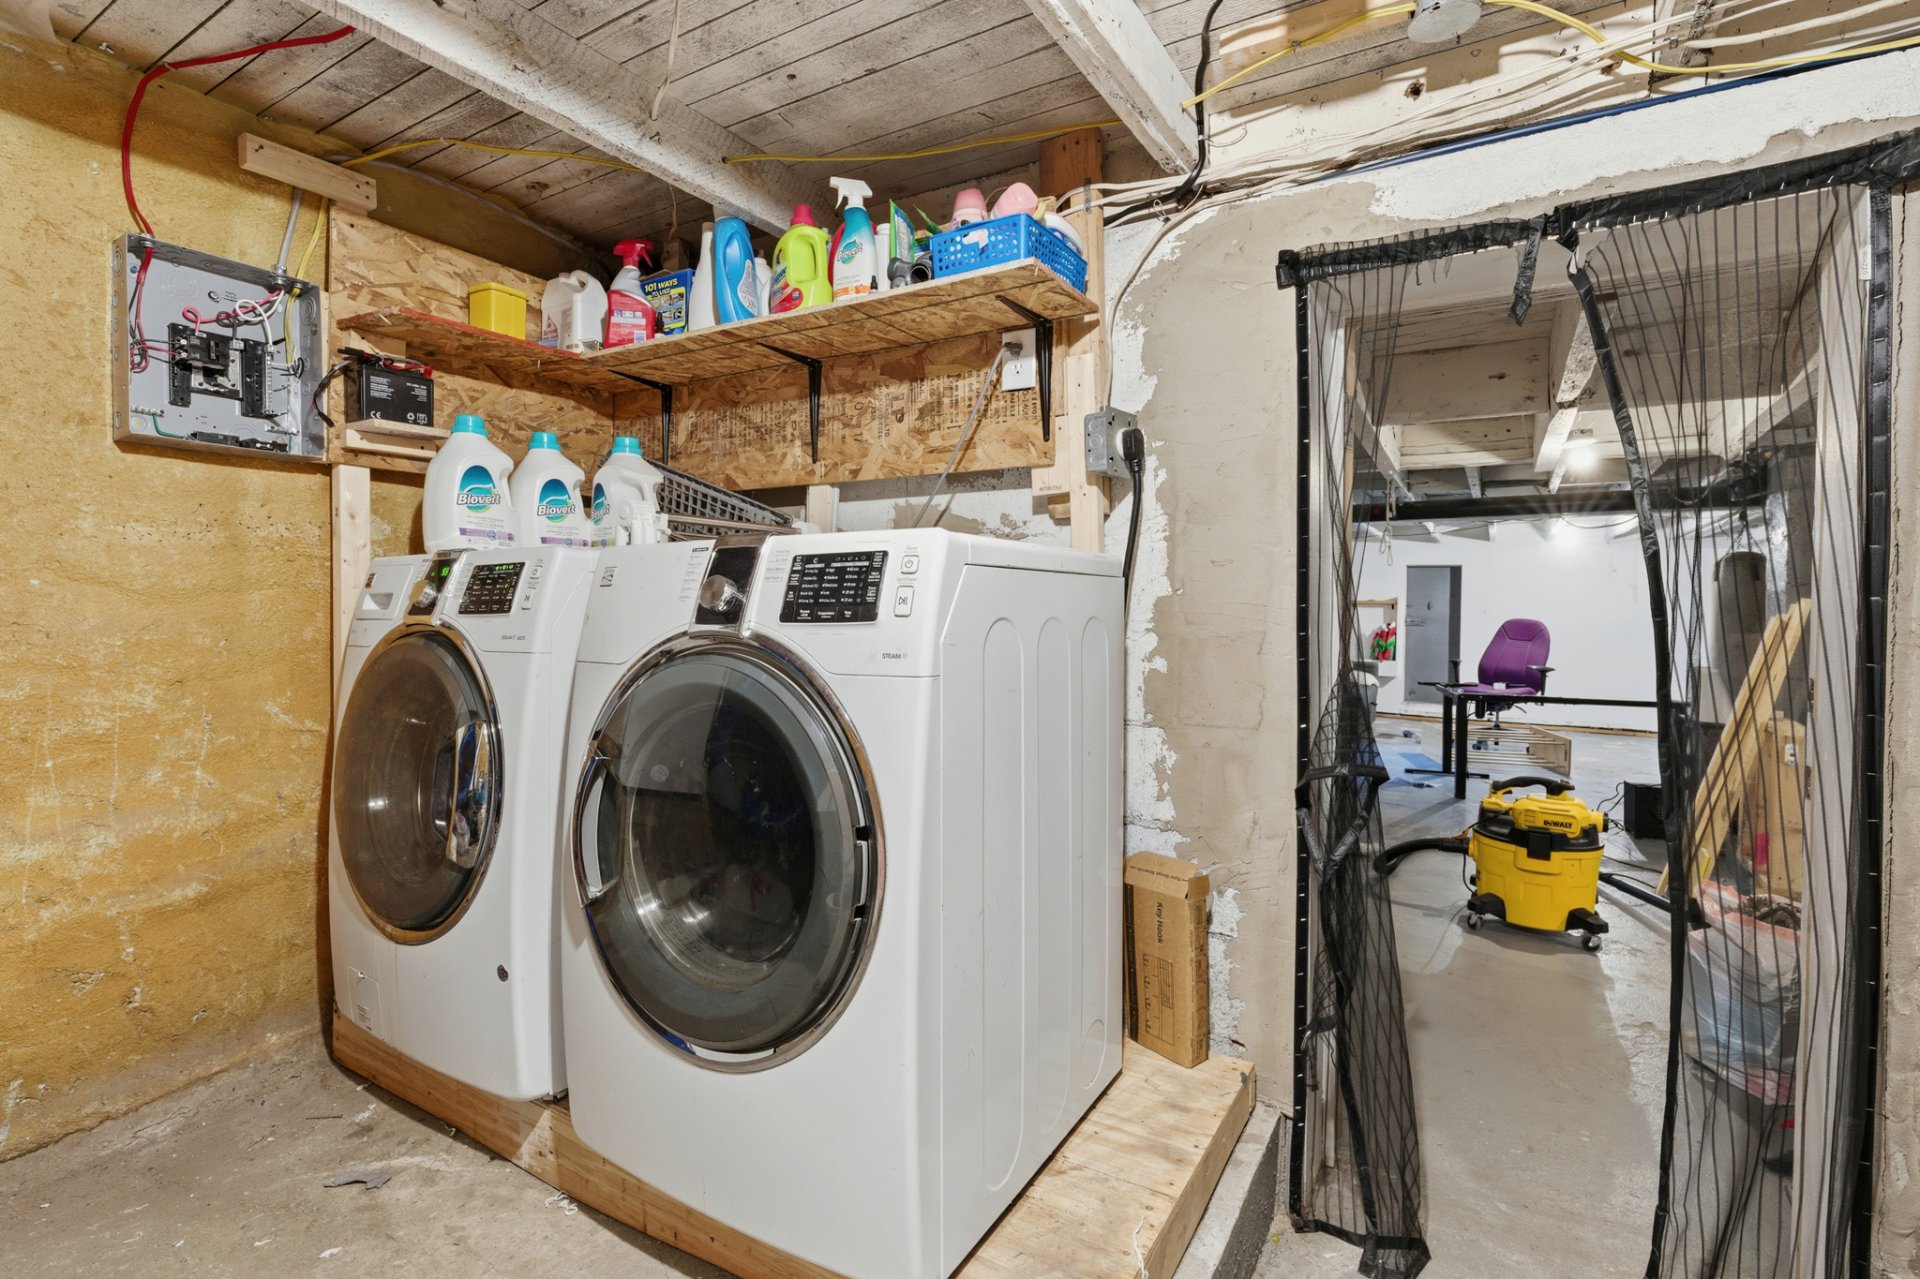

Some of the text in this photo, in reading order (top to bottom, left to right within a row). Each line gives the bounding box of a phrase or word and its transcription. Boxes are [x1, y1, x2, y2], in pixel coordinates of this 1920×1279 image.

[644, 278, 678, 292] 101 WAYS
[457, 492, 501, 506] Biovert
[537, 503, 576, 518] Biovert
[1155, 901, 1164, 945] Key Hook
